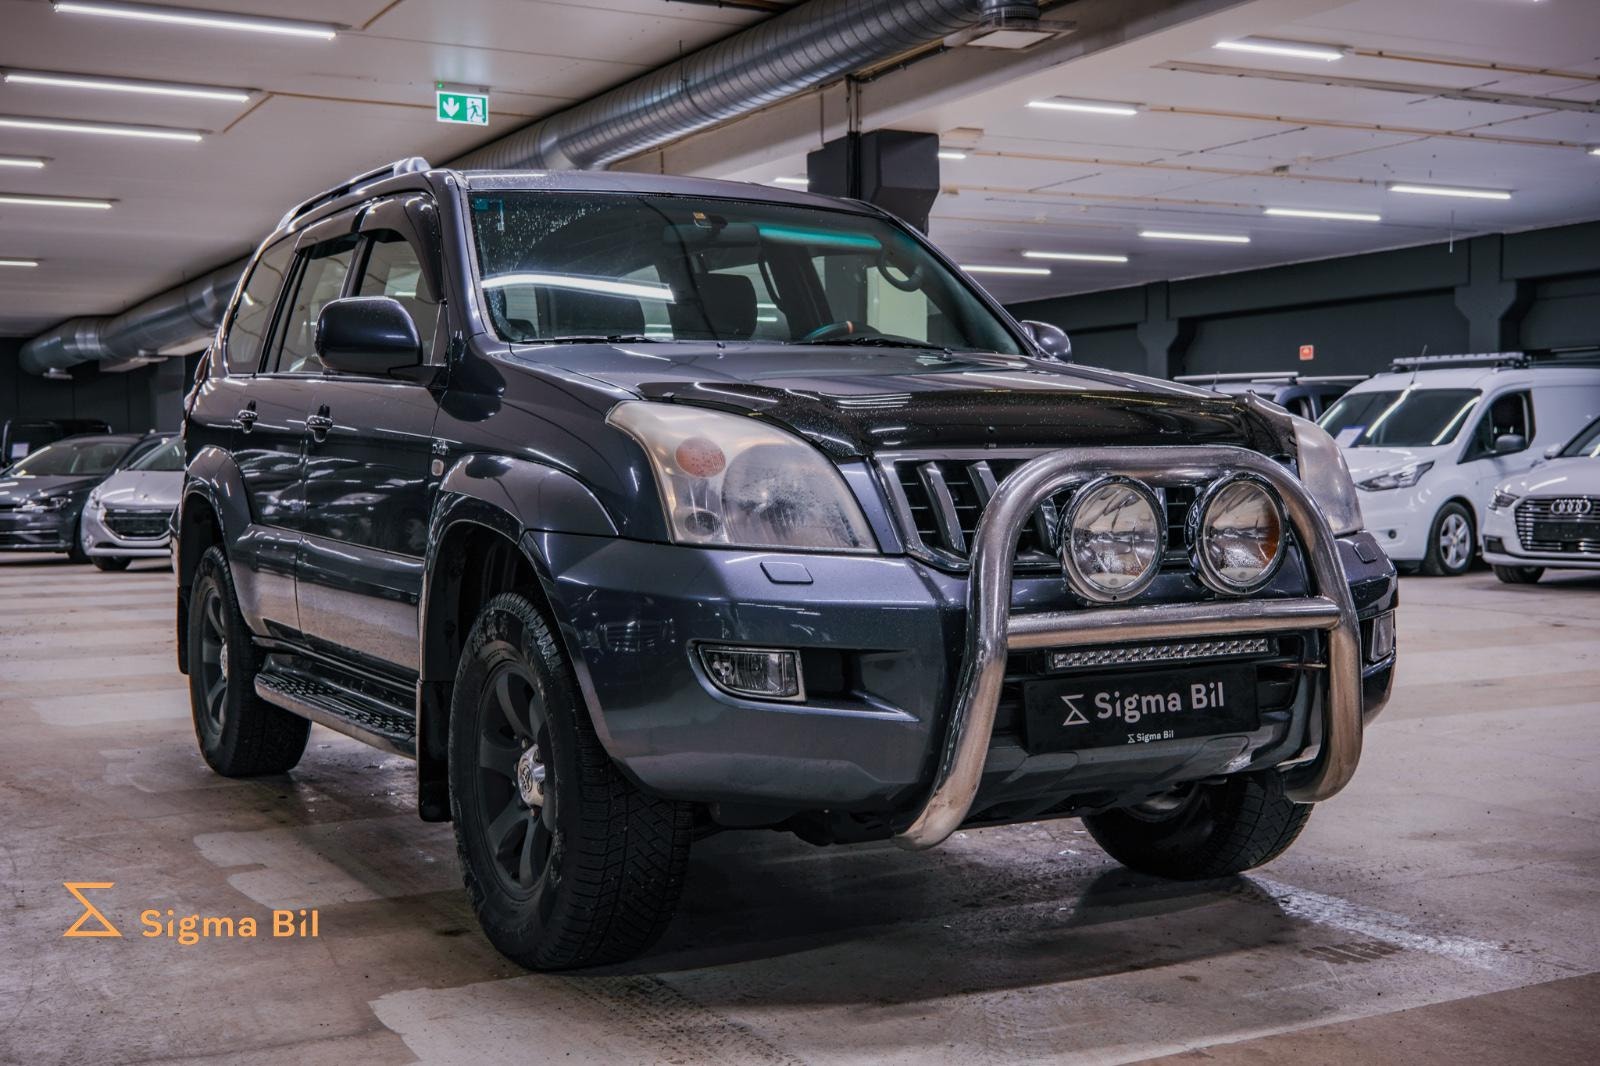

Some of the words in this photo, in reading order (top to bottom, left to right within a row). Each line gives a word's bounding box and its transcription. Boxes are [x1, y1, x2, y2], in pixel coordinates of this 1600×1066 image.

[1094, 690, 1182, 724] Sigma
[1190, 681, 1225, 710] Bil
[1136, 732, 1162, 743] Sigma
[1163, 730, 1174, 740] Bil
